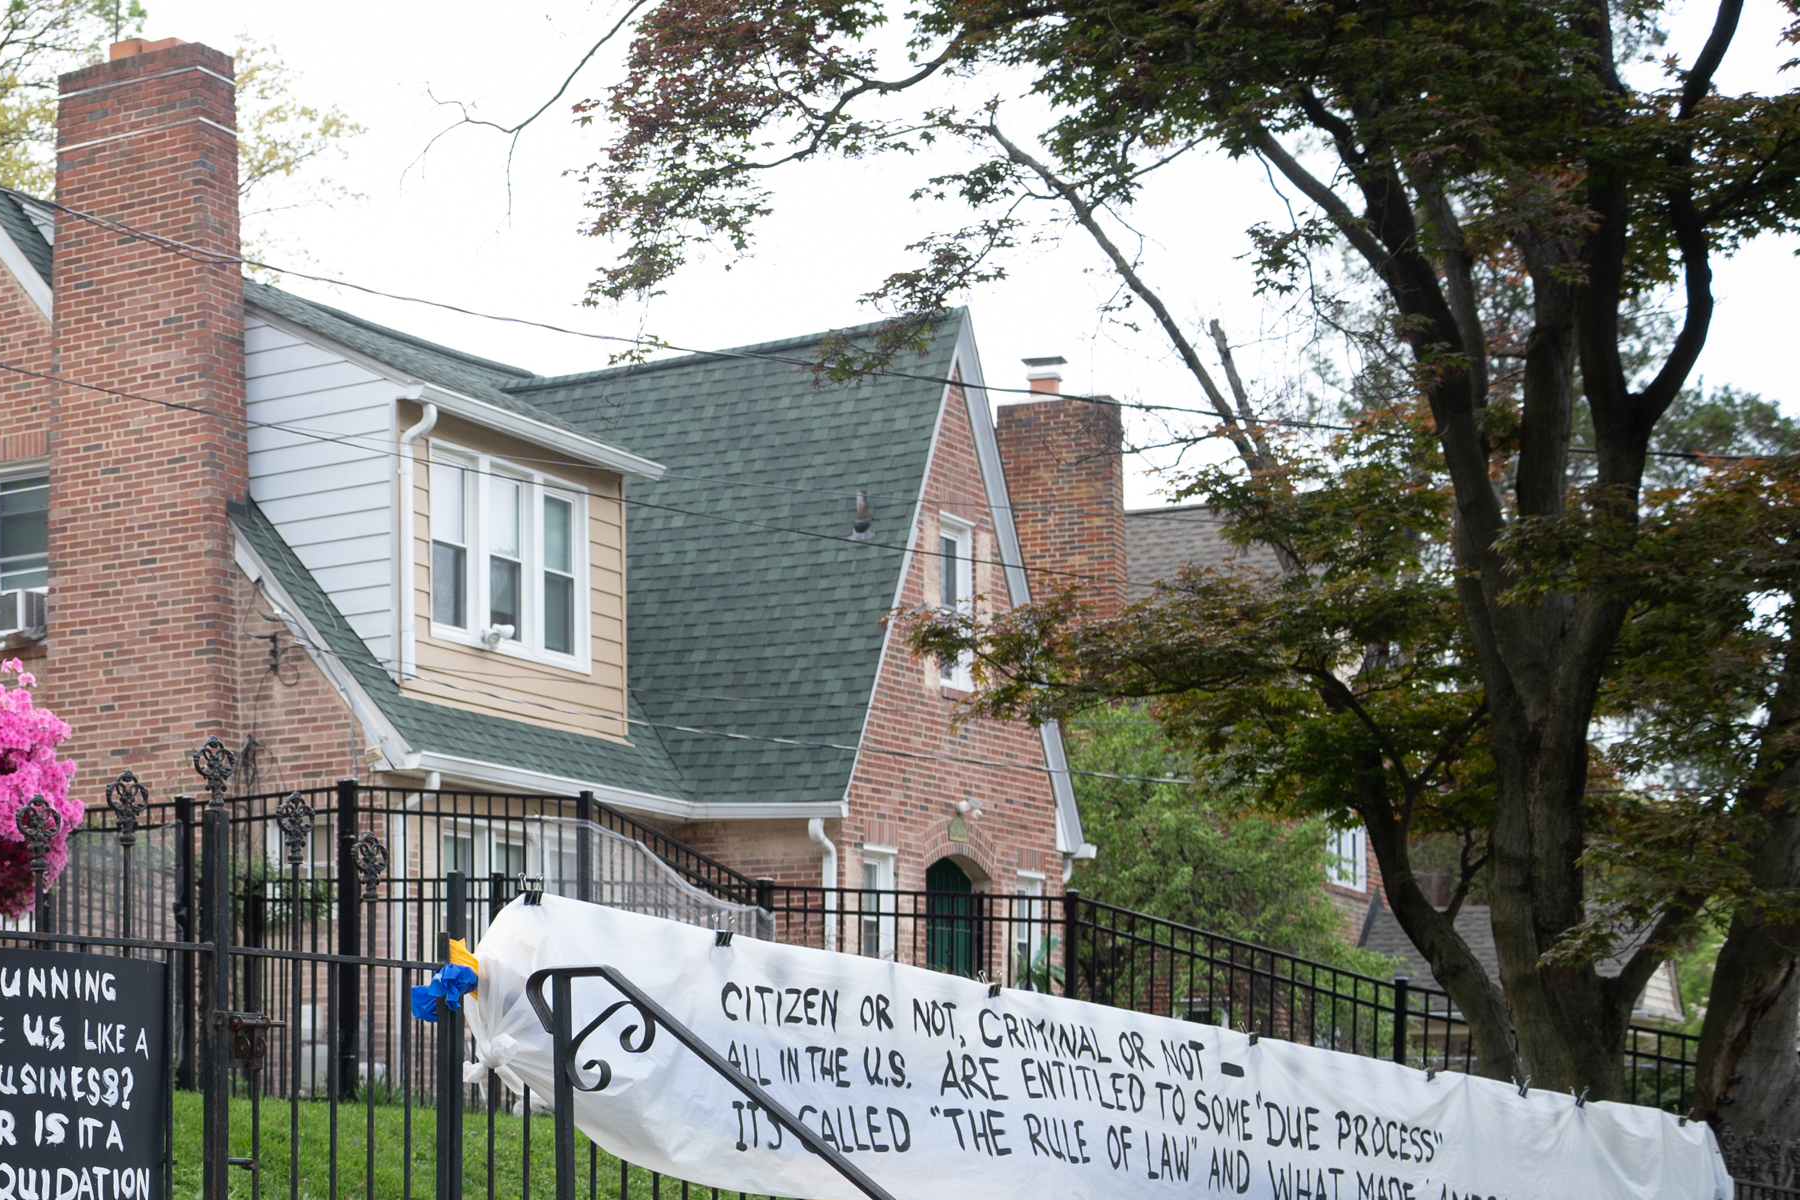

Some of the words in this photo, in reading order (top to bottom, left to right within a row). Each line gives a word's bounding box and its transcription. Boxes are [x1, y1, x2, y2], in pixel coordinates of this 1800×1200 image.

[84, 1019, 126, 1054] LIKE
[135, 1027, 149, 1060] A
[721, 982, 839, 1033] CITIZEN
[860, 994, 894, 1032] OR
[913, 998, 966, 1048] NOT,
[978, 1008, 1112, 1063] CRIMINAL
[1118, 1031, 1155, 1072] OR
[1161, 1039, 1205, 1081] NOT
[34, 1110, 69, 1147] IS
[728, 1040, 771, 1086] ALL
[780, 1047, 800, 1085] IN
[805, 1046, 850, 1088] THE
[864, 1046, 912, 1089] U.S.
[941, 1050, 1009, 1101] ARE
[1021, 1058, 1145, 1113] ENTITLED
[1155, 1082, 1185, 1125] TO
[1194, 1089, 1253, 1142] SOME
[798, 1104, 911, 1154] CALLED
[1023, 1113, 1090, 1164] RULE
[1107, 1124, 1132, 1172] OF
[1208, 1147, 1250, 1194] AND
